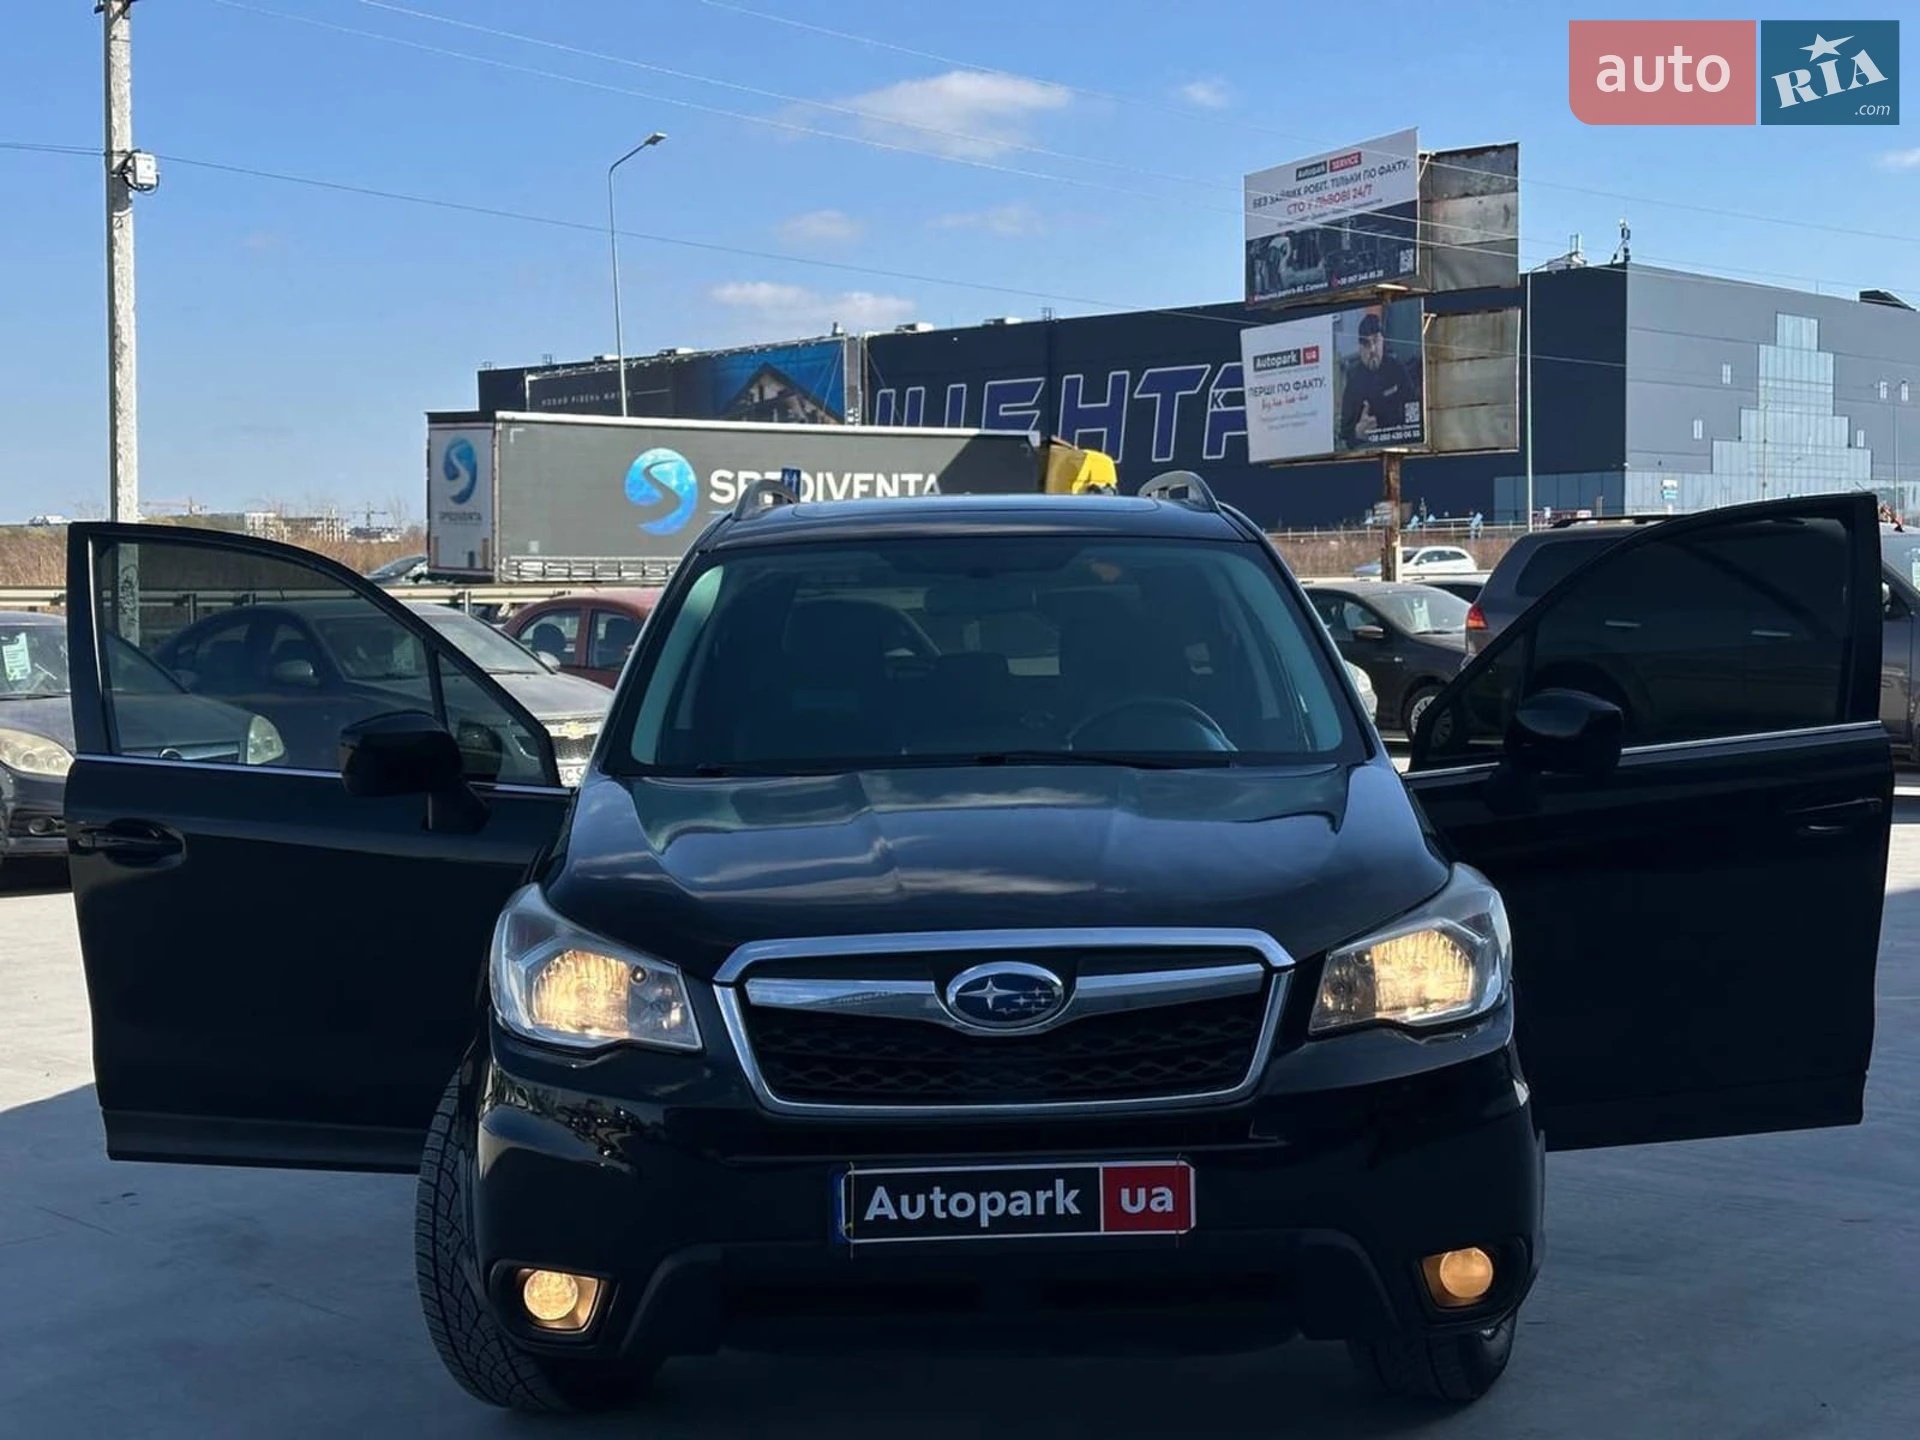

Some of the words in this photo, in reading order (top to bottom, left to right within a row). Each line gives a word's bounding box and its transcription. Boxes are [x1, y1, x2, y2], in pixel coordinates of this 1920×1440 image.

[1253, 196, 1267, 208] БЕЗ
[1363, 167, 1376, 180] ПО
[1287, 201, 1305, 215] СТО
[1352, 183, 1373, 199] 24/7
[1256, 350, 1298, 368] Autopark
[1305, 350, 1317, 361] ua
[1249, 384, 1275, 397] ПЕРШІ
[1277, 382, 1291, 393] ПО
[1293, 376, 1327, 391] ФАКТУ.
[864, 1179, 1081, 1227] Autopark
[1121, 1186, 1175, 1213] ua
